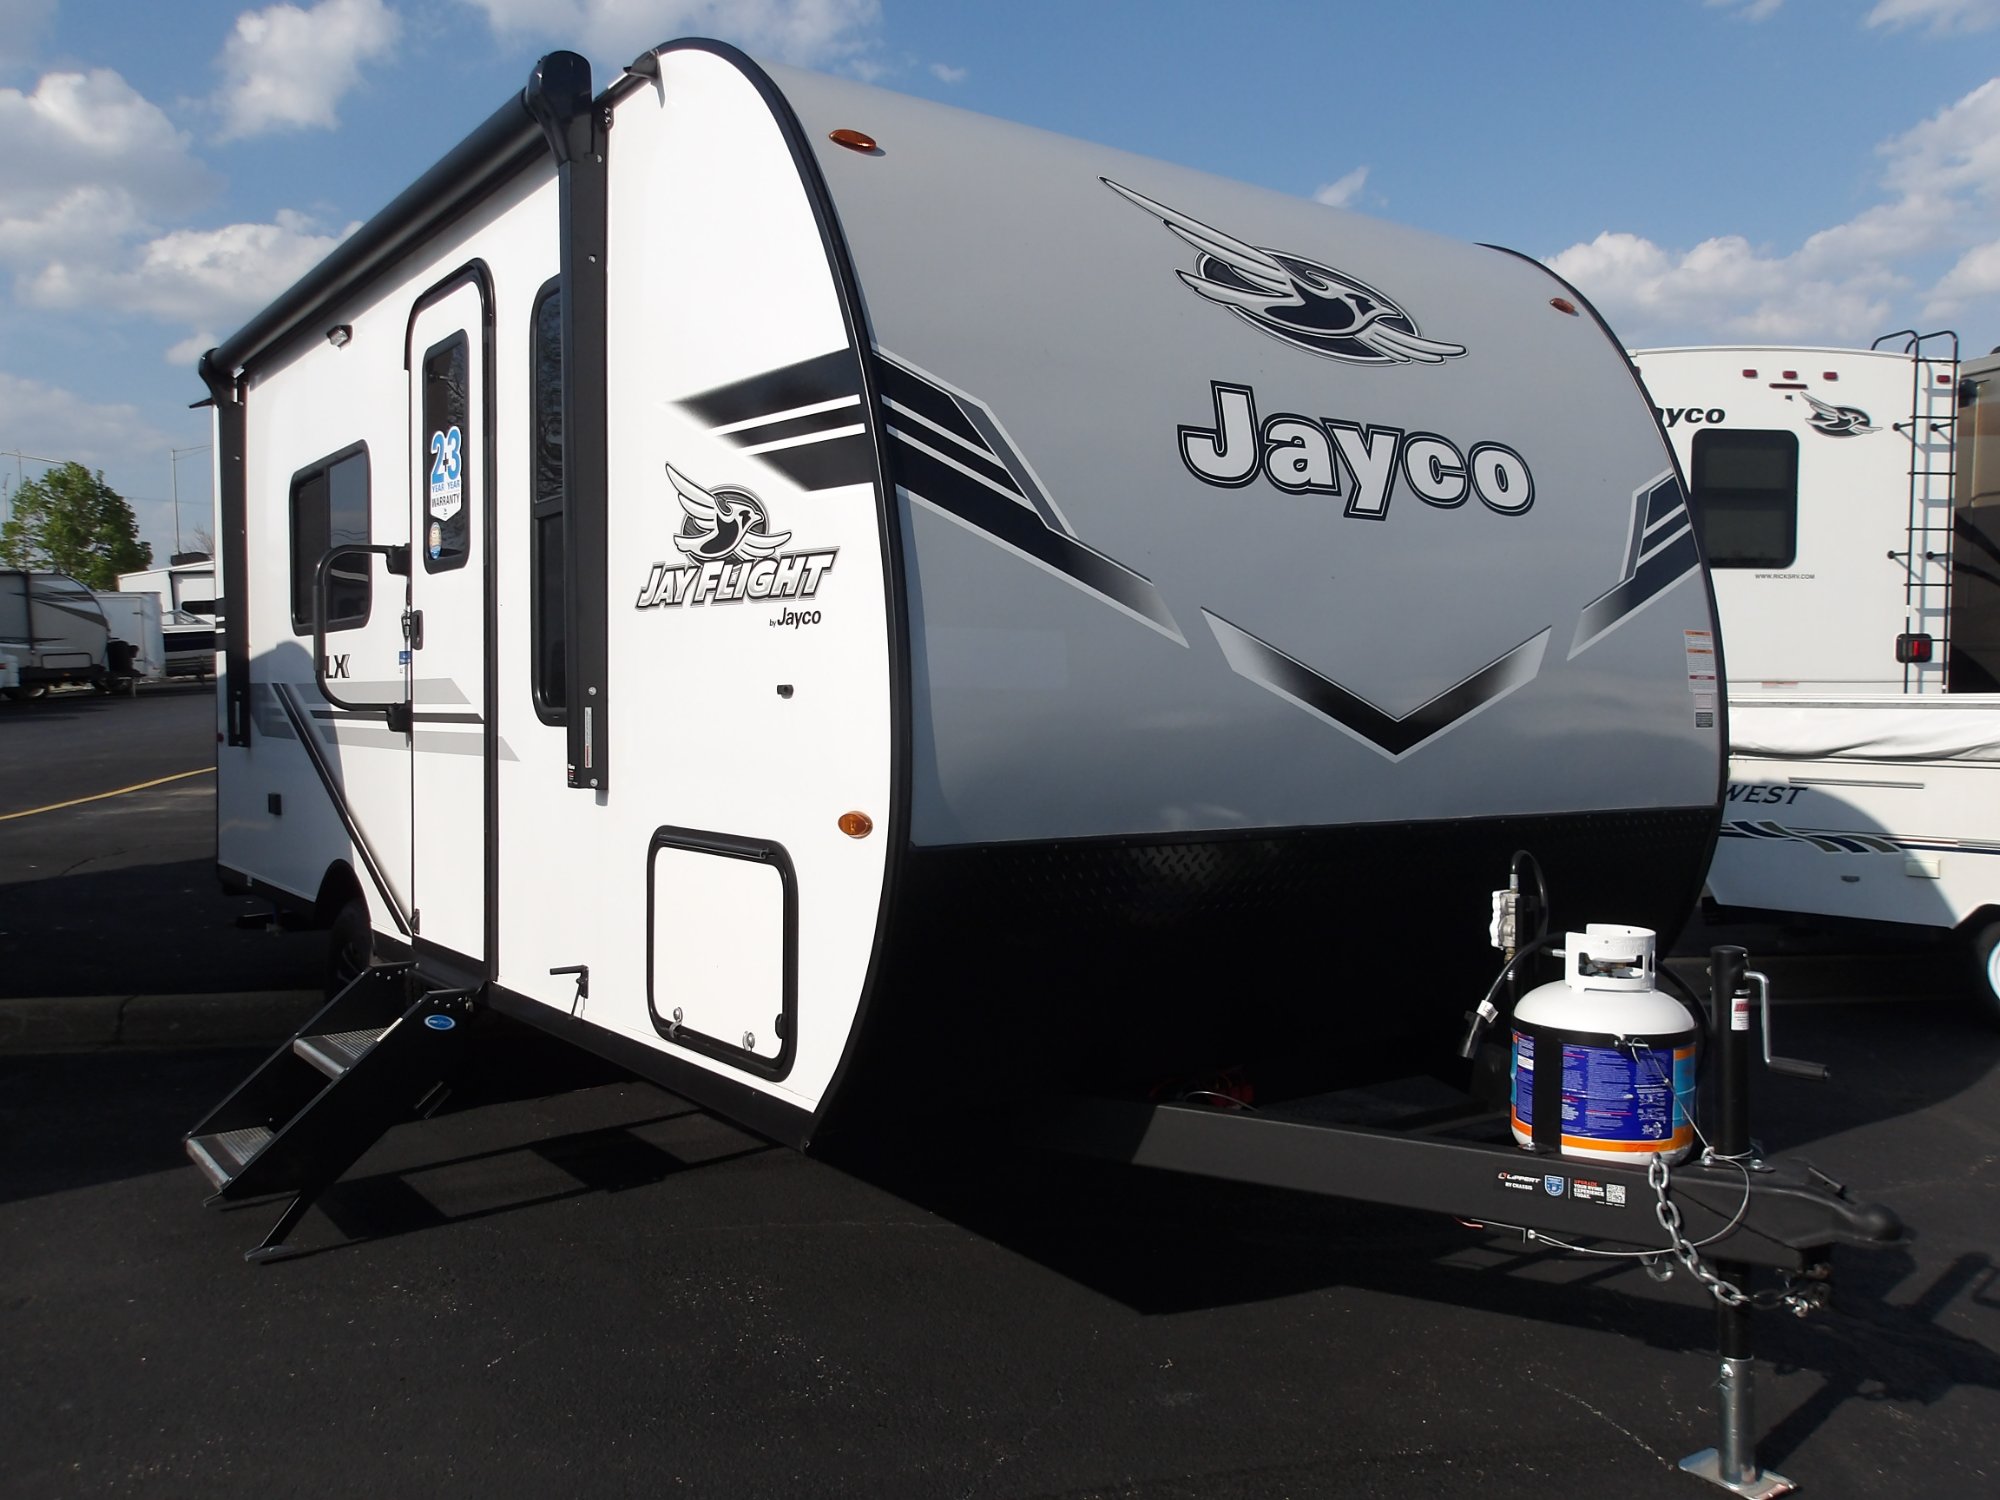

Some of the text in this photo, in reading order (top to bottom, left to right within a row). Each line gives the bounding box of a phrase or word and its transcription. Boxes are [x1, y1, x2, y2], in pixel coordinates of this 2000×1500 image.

[1177, 380, 1535, 521] Jayco
[432, 480, 460, 493] YEAR YEAR
[432, 493, 460, 508] WARRANTY
[635, 547, 840, 612] JAY FLIGHT
[769, 608, 821, 629] by Jayco
[1726, 784, 1808, 804] WEST
